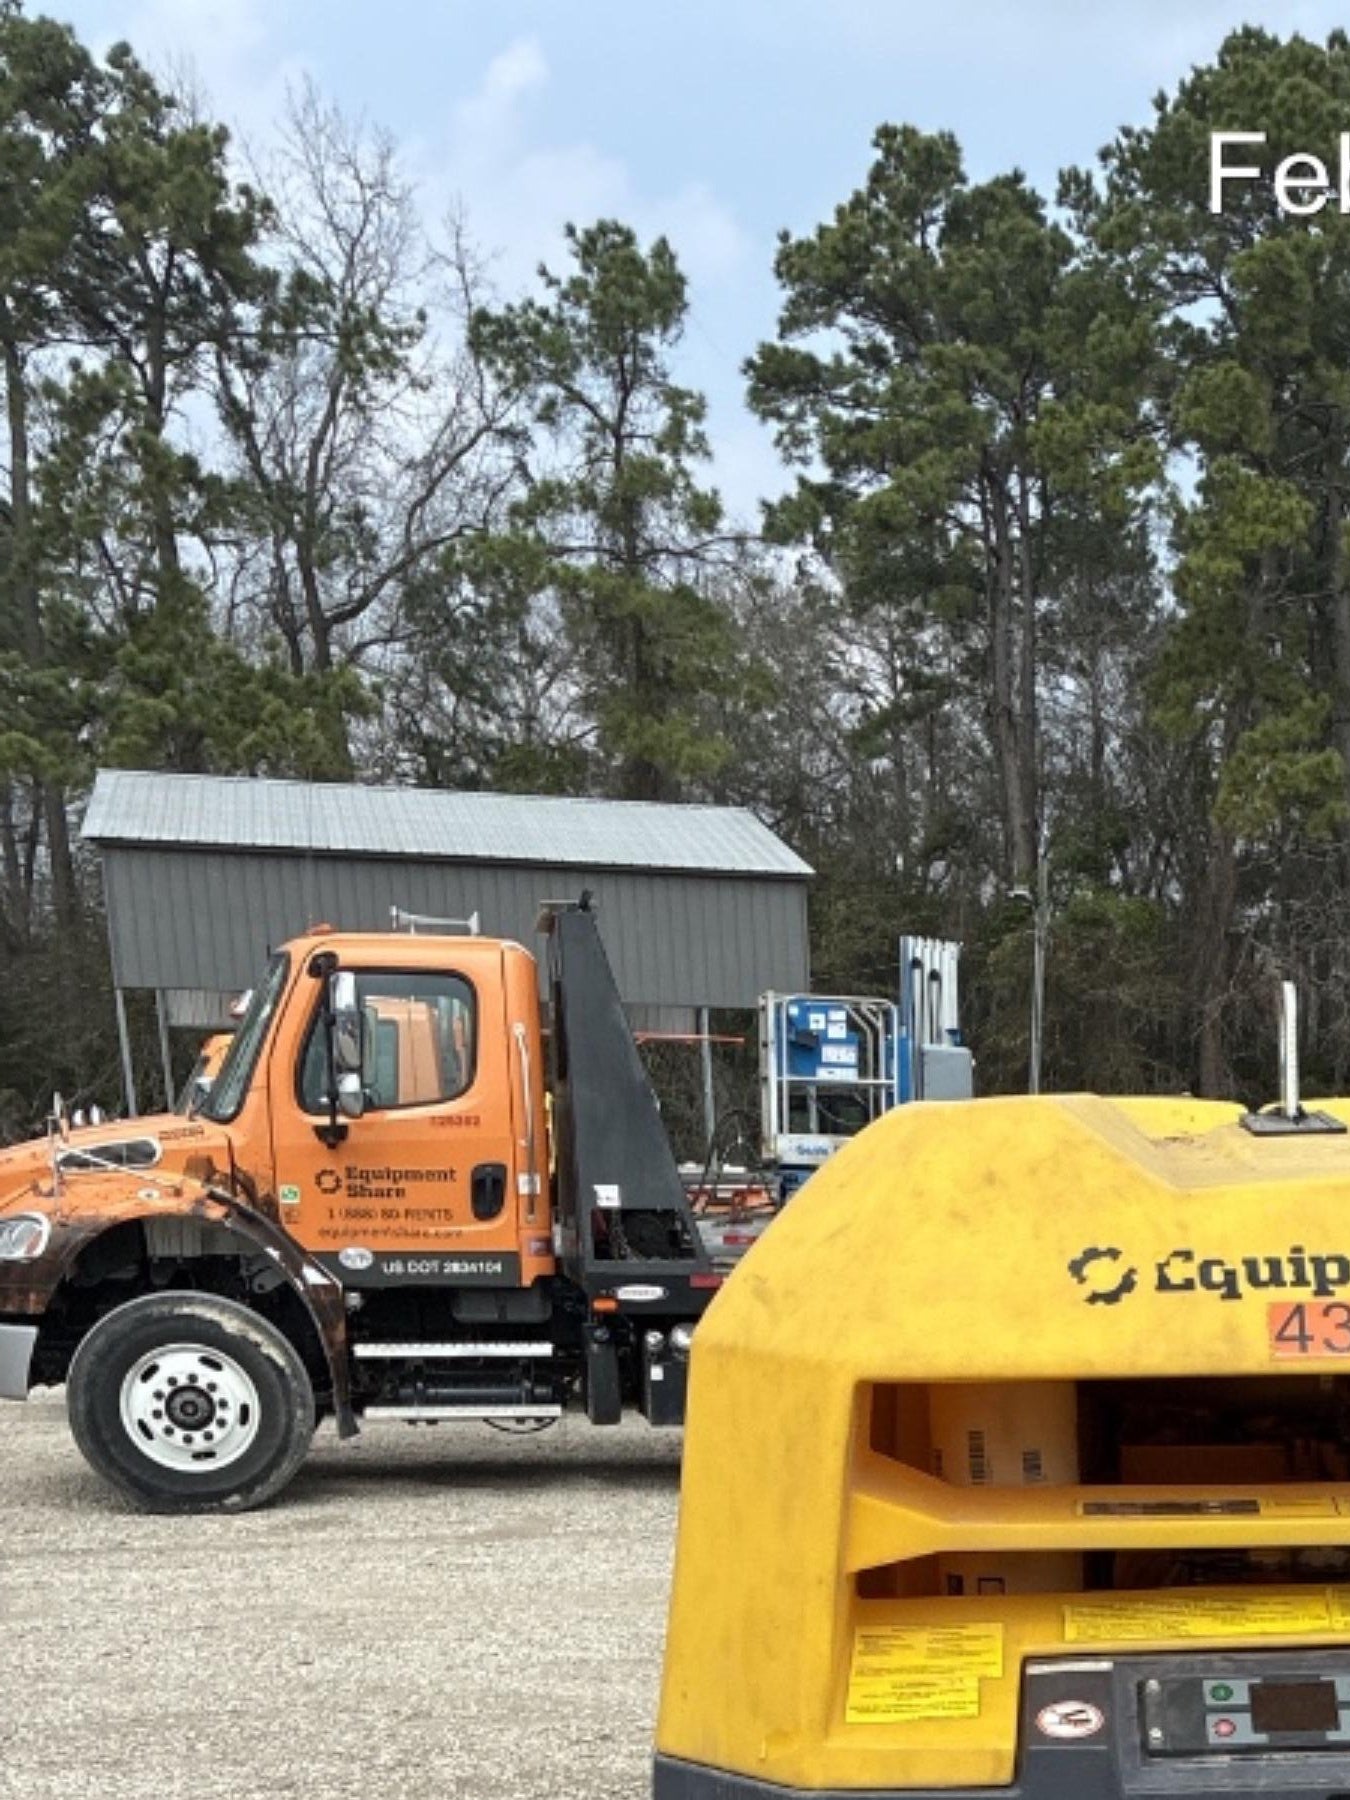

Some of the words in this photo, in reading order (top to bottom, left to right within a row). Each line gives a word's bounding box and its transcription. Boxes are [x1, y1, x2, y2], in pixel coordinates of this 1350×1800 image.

[344, 1166, 457, 1184] Equipment
[346, 1183, 406, 1198] Share
[382, 1260, 405, 1274] US
[407, 1260, 440, 1274] DOT
